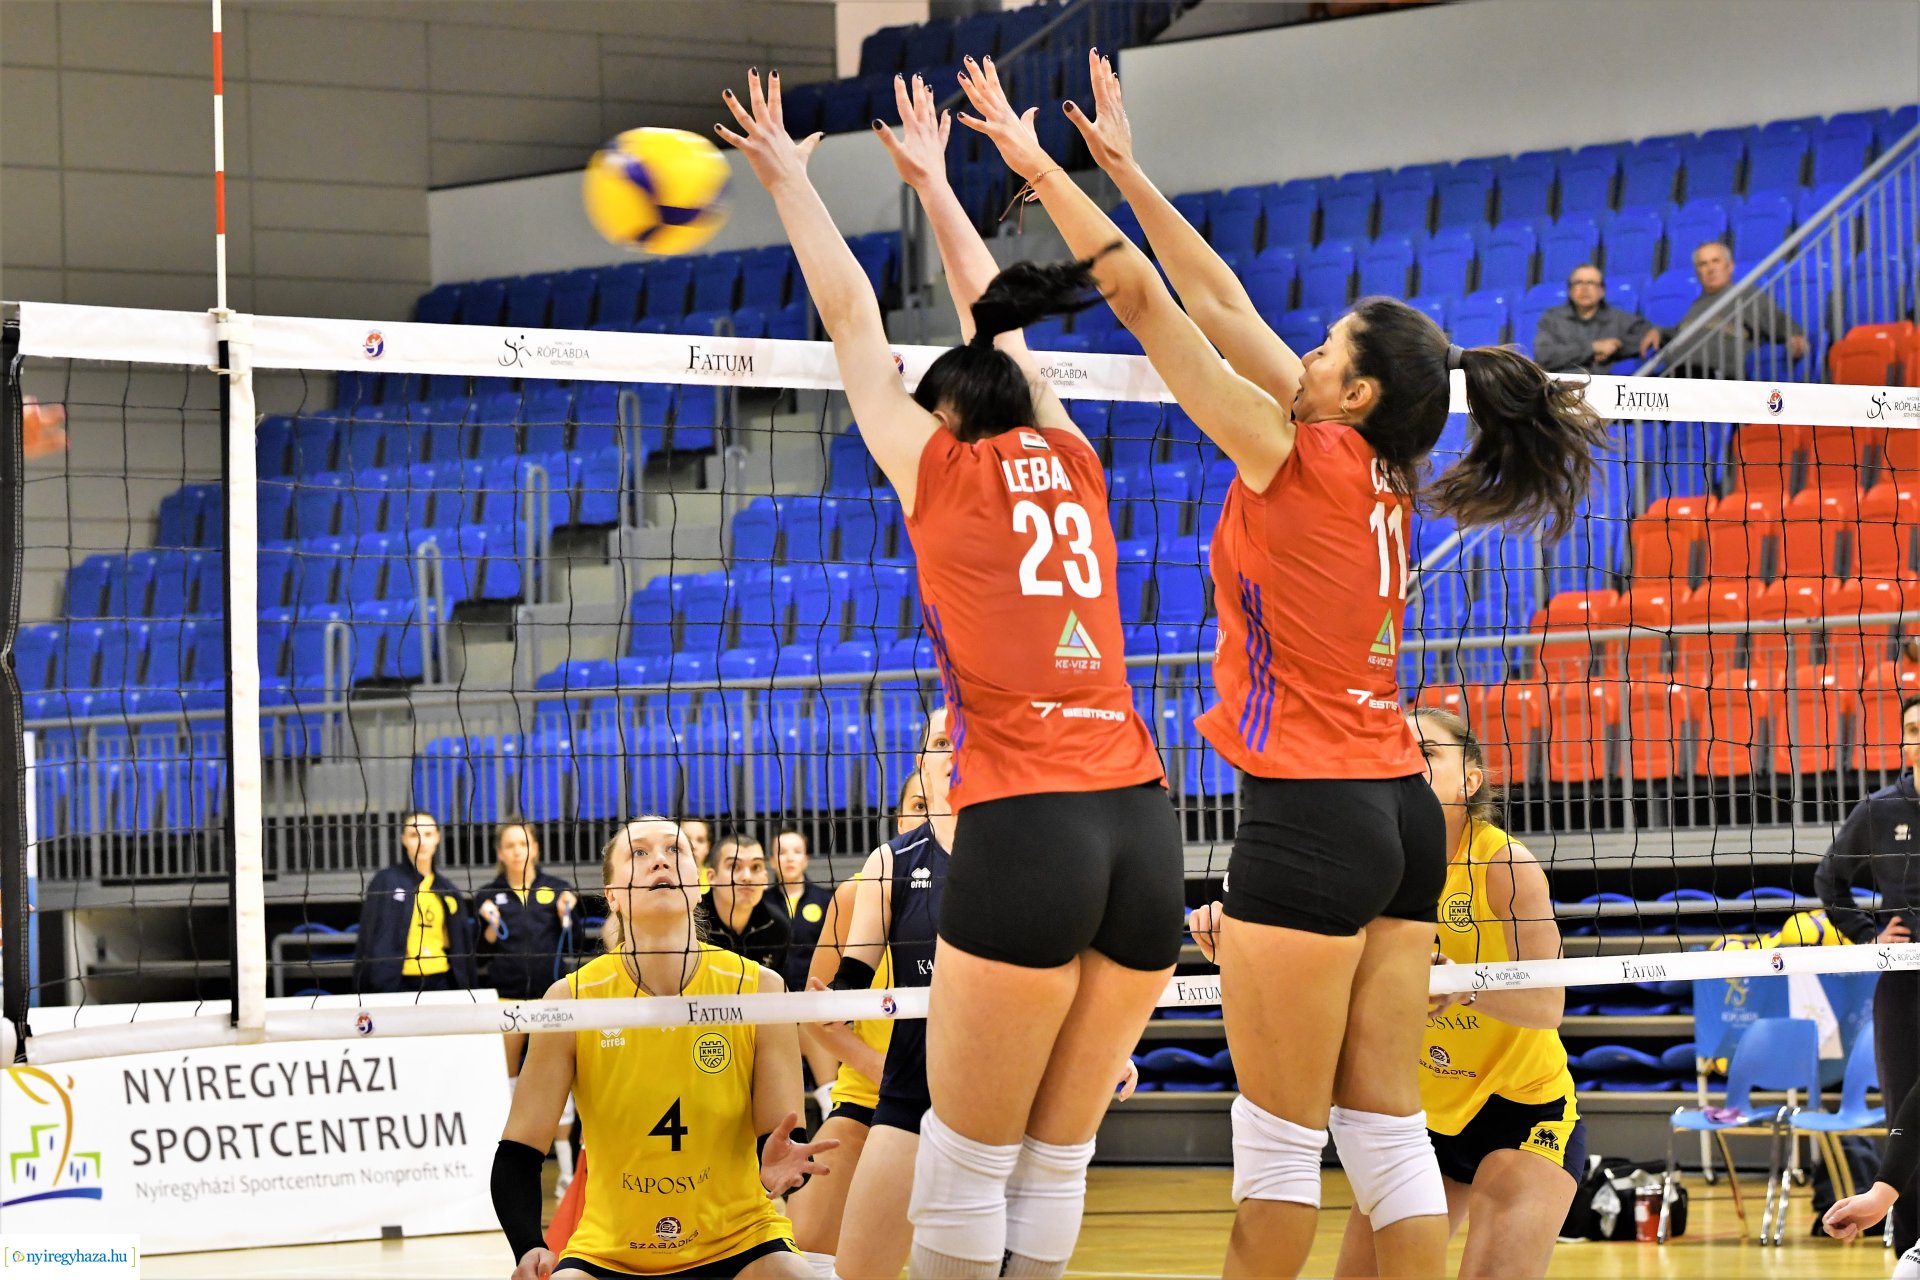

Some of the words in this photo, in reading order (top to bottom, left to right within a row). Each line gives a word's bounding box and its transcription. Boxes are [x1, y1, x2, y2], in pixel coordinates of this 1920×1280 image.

[1040, 366, 1087, 379] RÖPLABDA
[1002, 456, 1072, 493] LEBA
[1013, 500, 1102, 599] 23
[1369, 502, 1407, 600] 11
[1089, 661, 1101, 670] 21
[123, 1049, 398, 1104] NYÍREGYHÁZI
[130, 1112, 467, 1166] SPORTCENTRUM
[647, 1096, 688, 1151] 4
[240, 1168, 356, 1197] Sportcentrum
[360, 1162, 440, 1187] Nonprofit
[444, 1159, 473, 1180] Kft.
